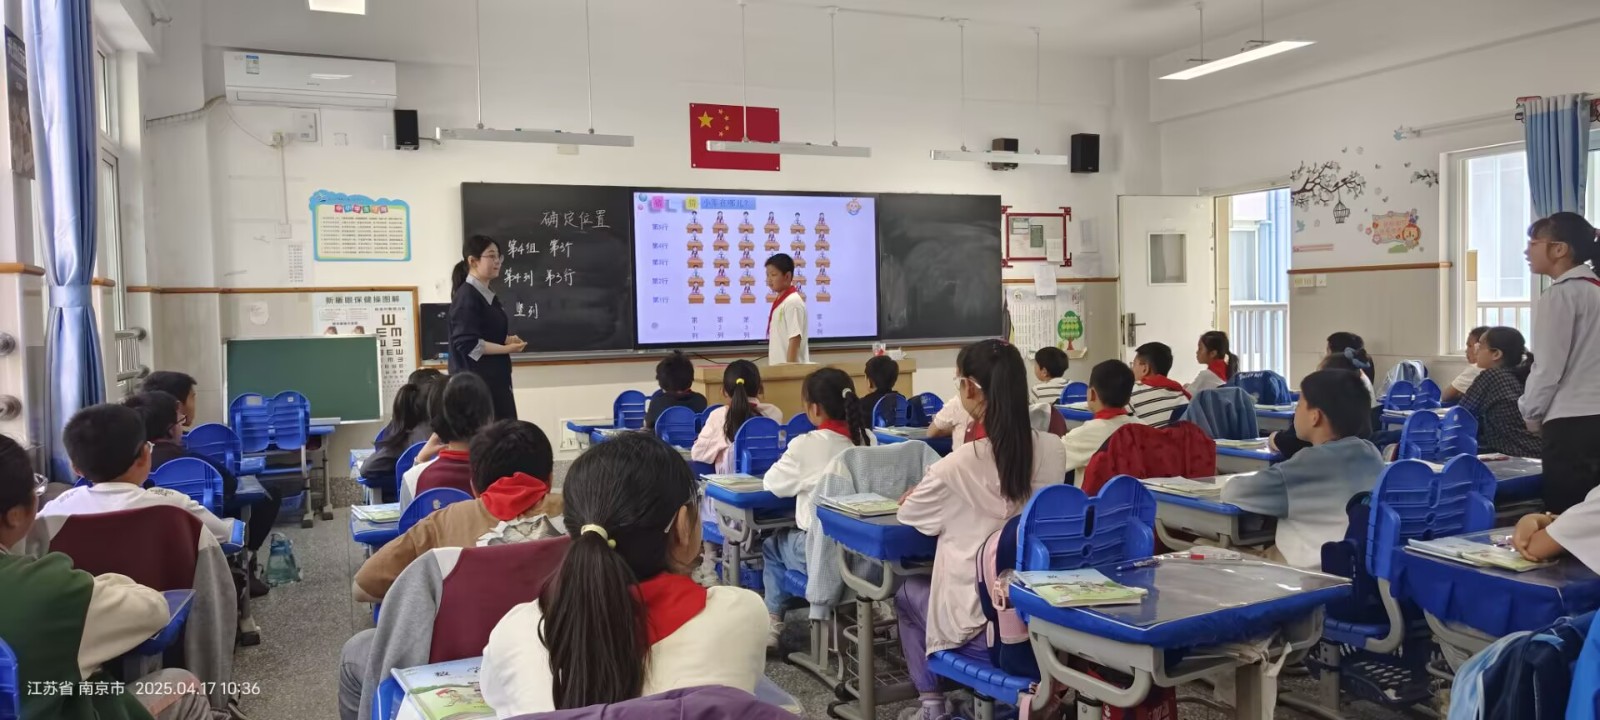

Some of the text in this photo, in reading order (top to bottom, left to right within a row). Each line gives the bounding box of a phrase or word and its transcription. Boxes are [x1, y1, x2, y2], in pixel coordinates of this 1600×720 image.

[540, 210, 611, 230] 确定位置
[507, 239, 573, 258] 第4组 第3个
[652, 242, 669, 251] 第4行
[503, 267, 576, 287] 第4列 第3行
[652, 277, 669, 286] 第2行
[325, 295, 400, 304] 新版眼保健操图解
